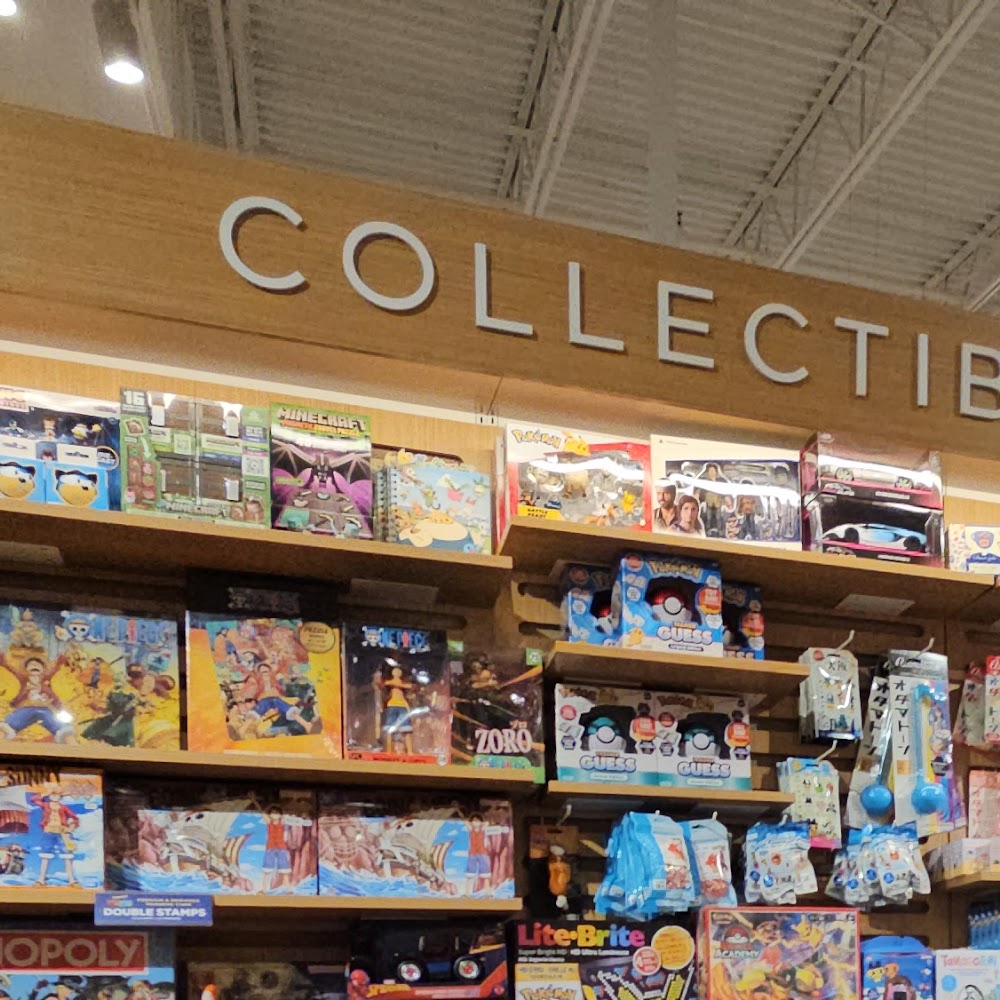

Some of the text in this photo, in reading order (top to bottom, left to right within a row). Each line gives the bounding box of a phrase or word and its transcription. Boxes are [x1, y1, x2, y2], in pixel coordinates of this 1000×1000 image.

[124, 391, 144, 406] 16
[277, 409, 366, 432] MINECRAFT
[657, 626, 713, 646] GUESS
[474, 728, 533, 754] ZORO
[579, 754, 637, 774] GUESS
[677, 760, 731, 779] GUESS
[103, 907, 207, 918] DOUBLE STAMPS
